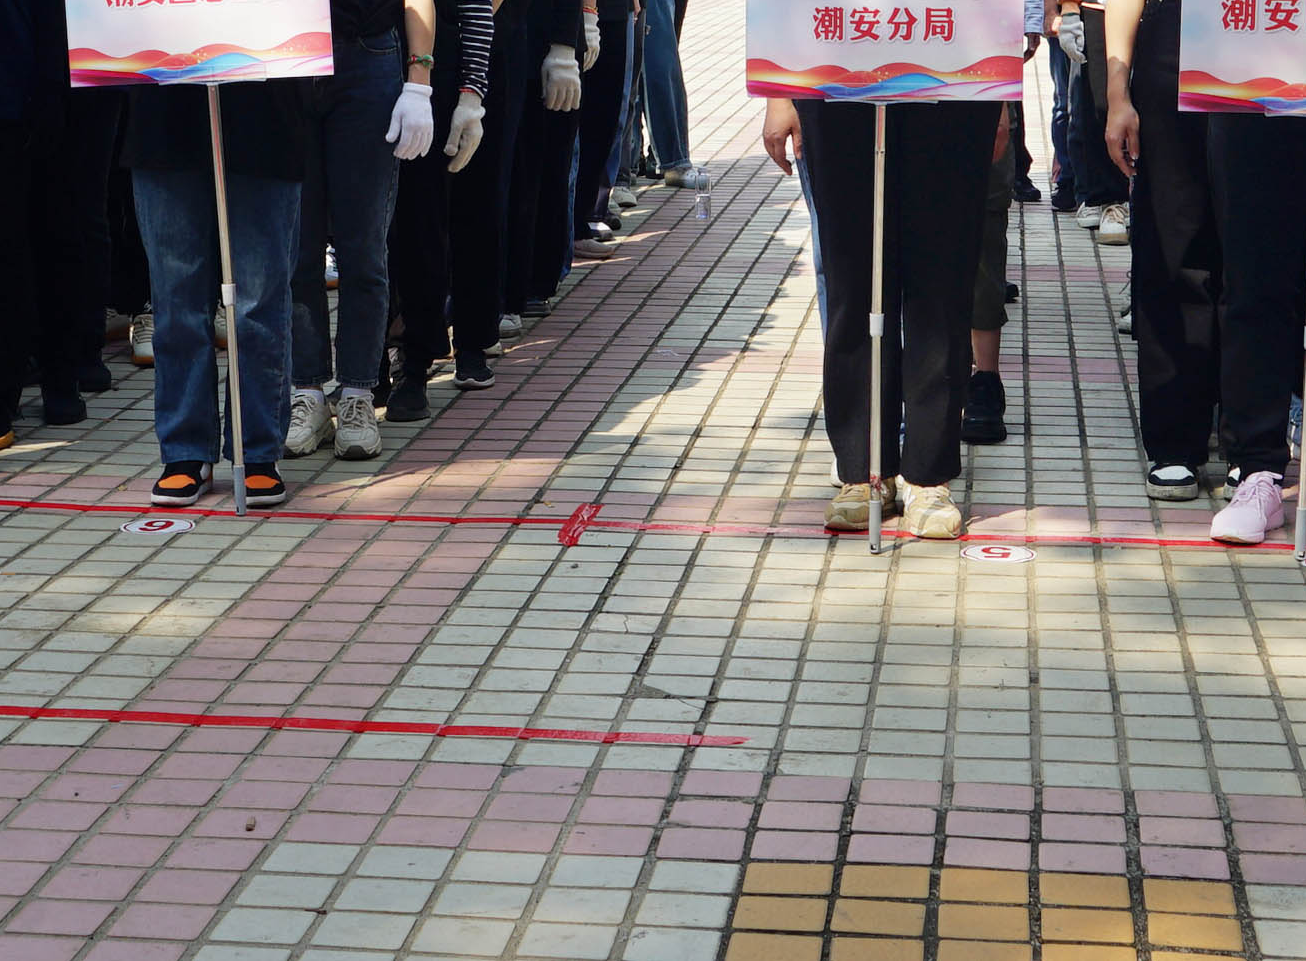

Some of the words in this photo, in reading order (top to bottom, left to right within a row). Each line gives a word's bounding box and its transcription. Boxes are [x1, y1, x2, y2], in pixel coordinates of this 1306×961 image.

[813, 7, 955, 42] 潮安分局
[980, 546, 1009, 558] 5
